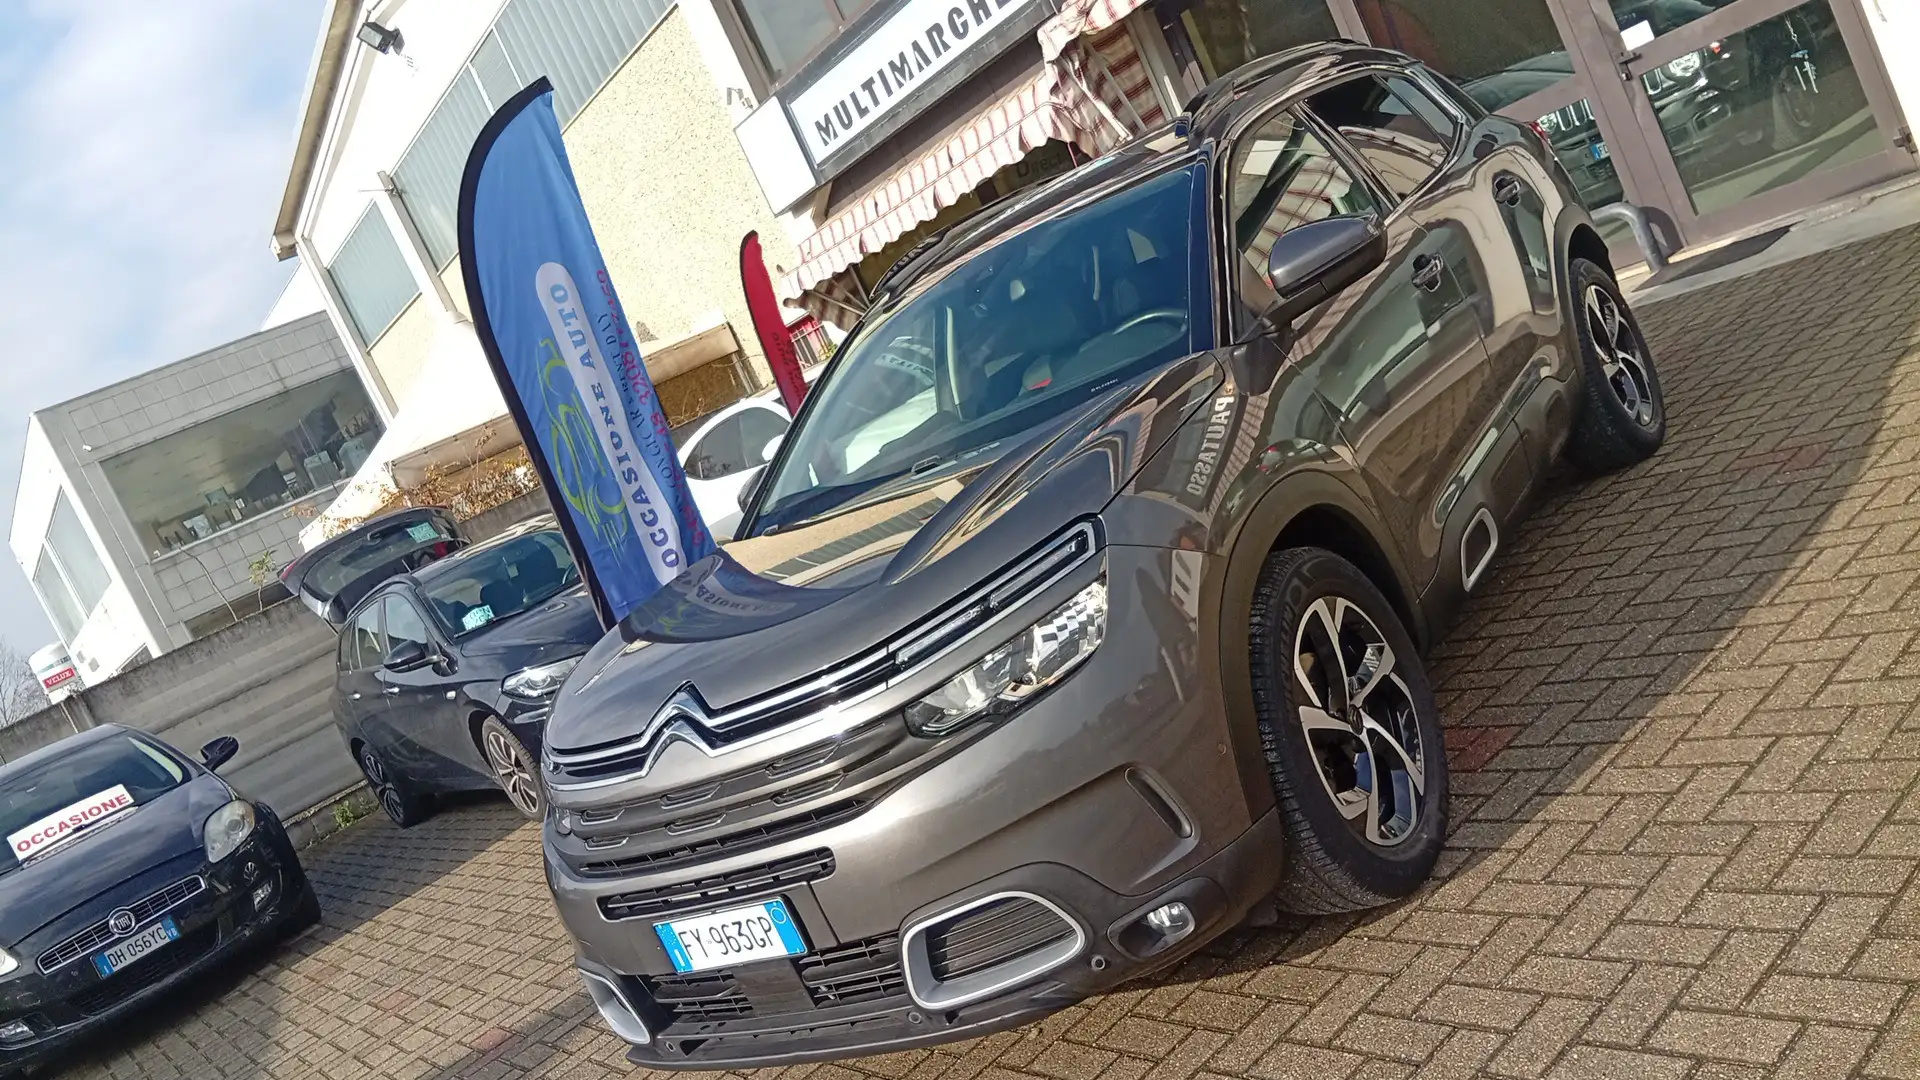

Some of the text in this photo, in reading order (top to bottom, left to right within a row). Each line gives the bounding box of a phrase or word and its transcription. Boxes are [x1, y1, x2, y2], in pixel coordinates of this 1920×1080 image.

[550, 284, 595, 370] AUTO
[590, 382, 680, 568] OCCASIONE
[46, 670, 72, 685] VELUX
[17, 794, 130, 852] OCCASIONE
[116, 915, 131, 930] FIAT
[677, 928, 709, 961] FY
[708, 916, 774, 956] 963GP
[107, 949, 127, 968] DH
[126, 927, 167, 957] 056YC
